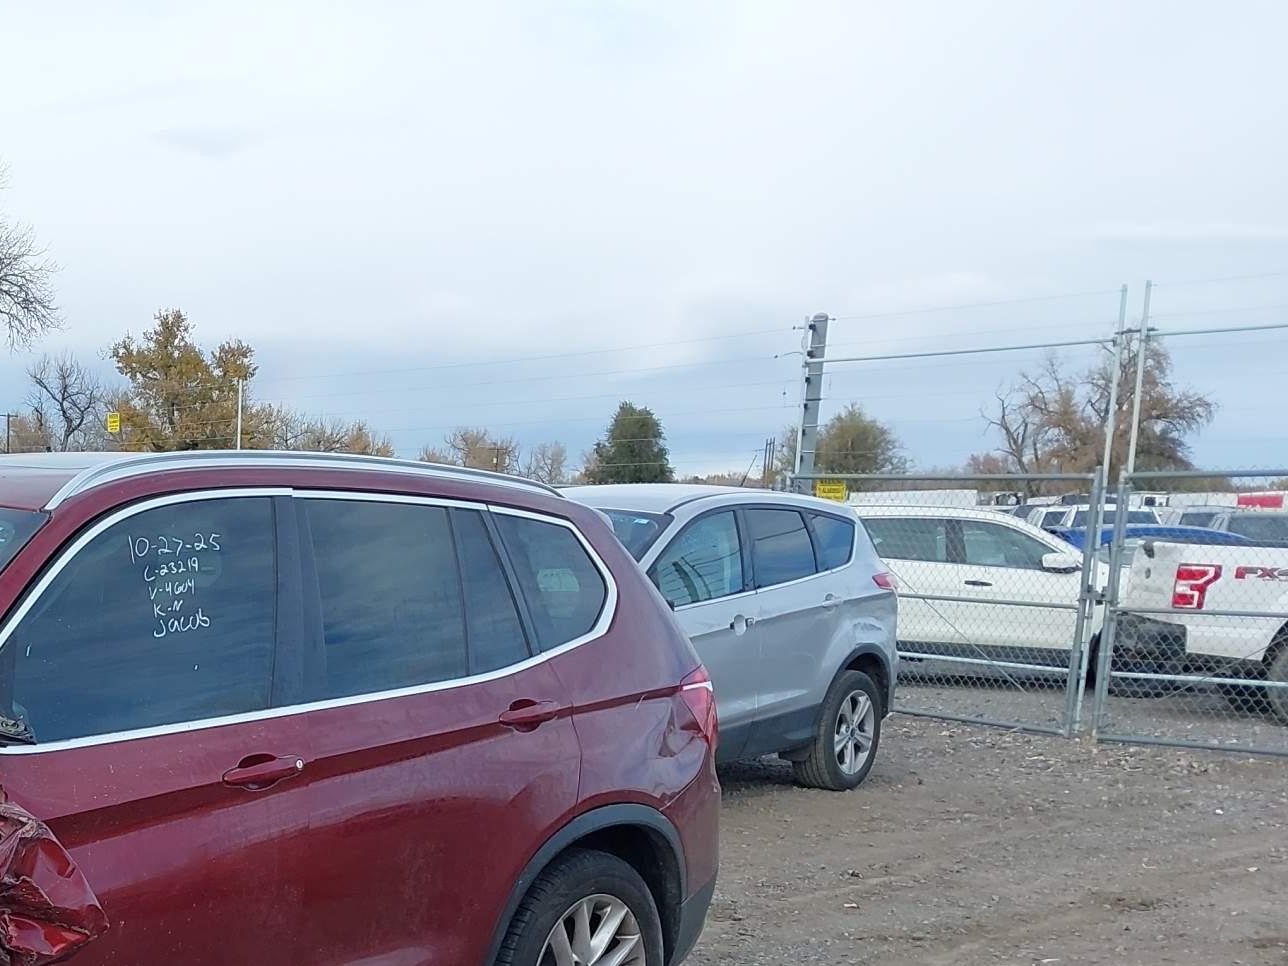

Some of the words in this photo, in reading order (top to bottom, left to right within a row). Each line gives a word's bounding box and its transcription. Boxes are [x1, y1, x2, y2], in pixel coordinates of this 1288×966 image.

[128, 533, 221, 564] 10-27-25
[153, 600, 184, 618] K-N
[153, 607, 211, 637] Jacob
